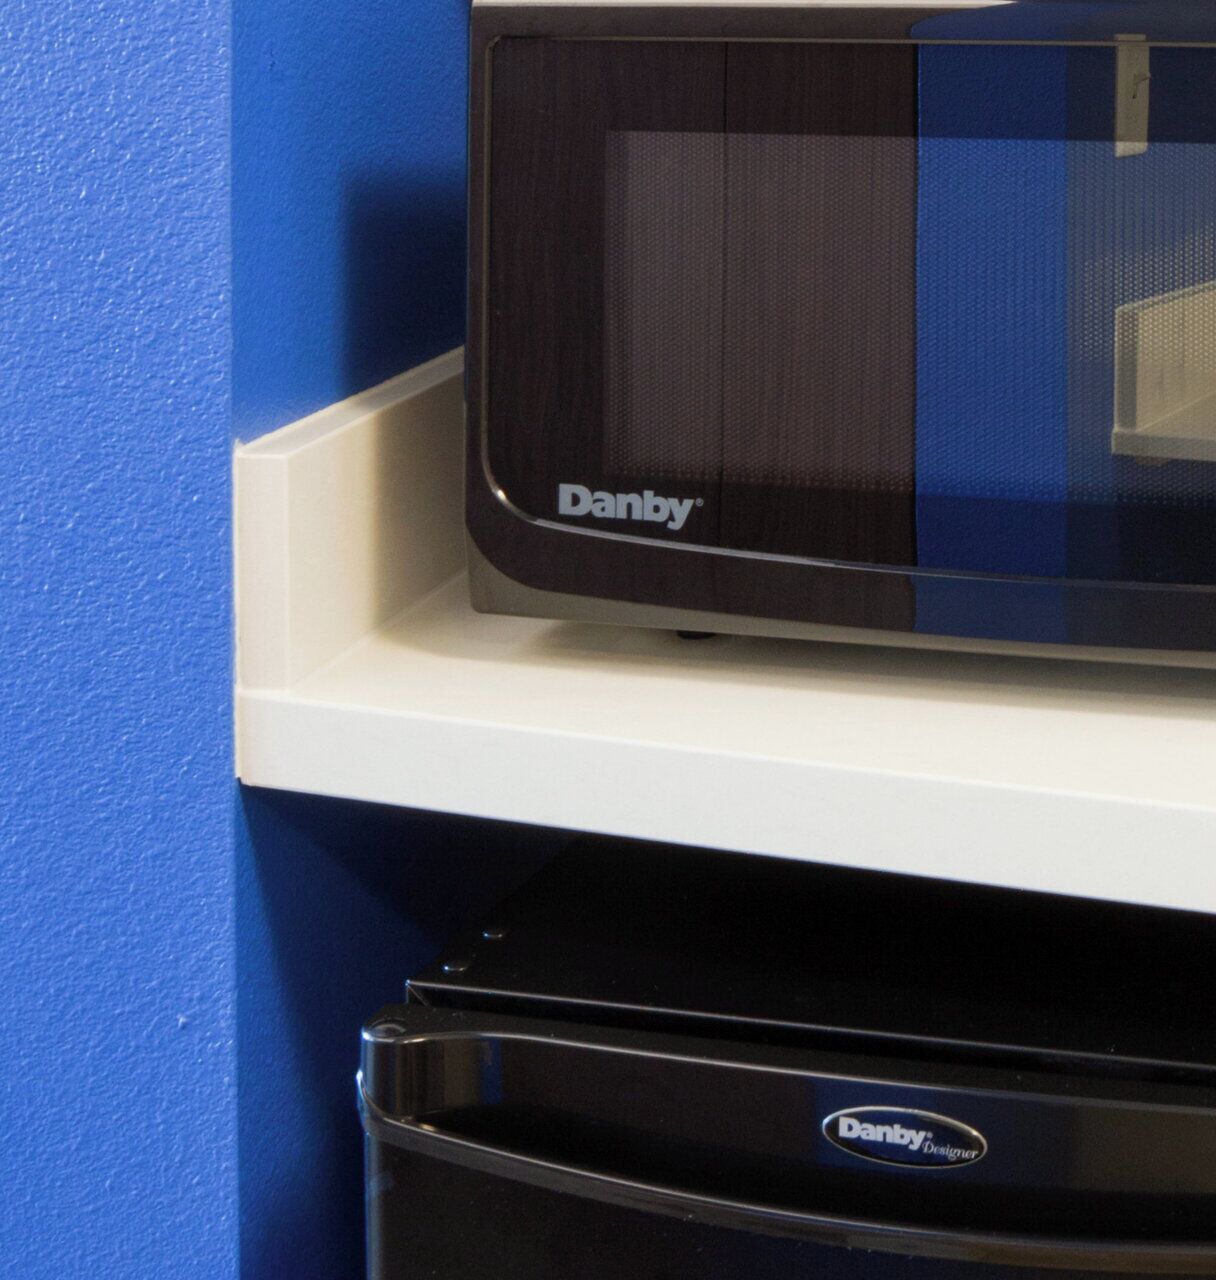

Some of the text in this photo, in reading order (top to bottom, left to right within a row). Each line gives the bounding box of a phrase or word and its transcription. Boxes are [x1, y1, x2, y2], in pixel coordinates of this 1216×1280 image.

[559, 483, 694, 531] Danby
[839, 1116, 979, 1161] Danby Designer
